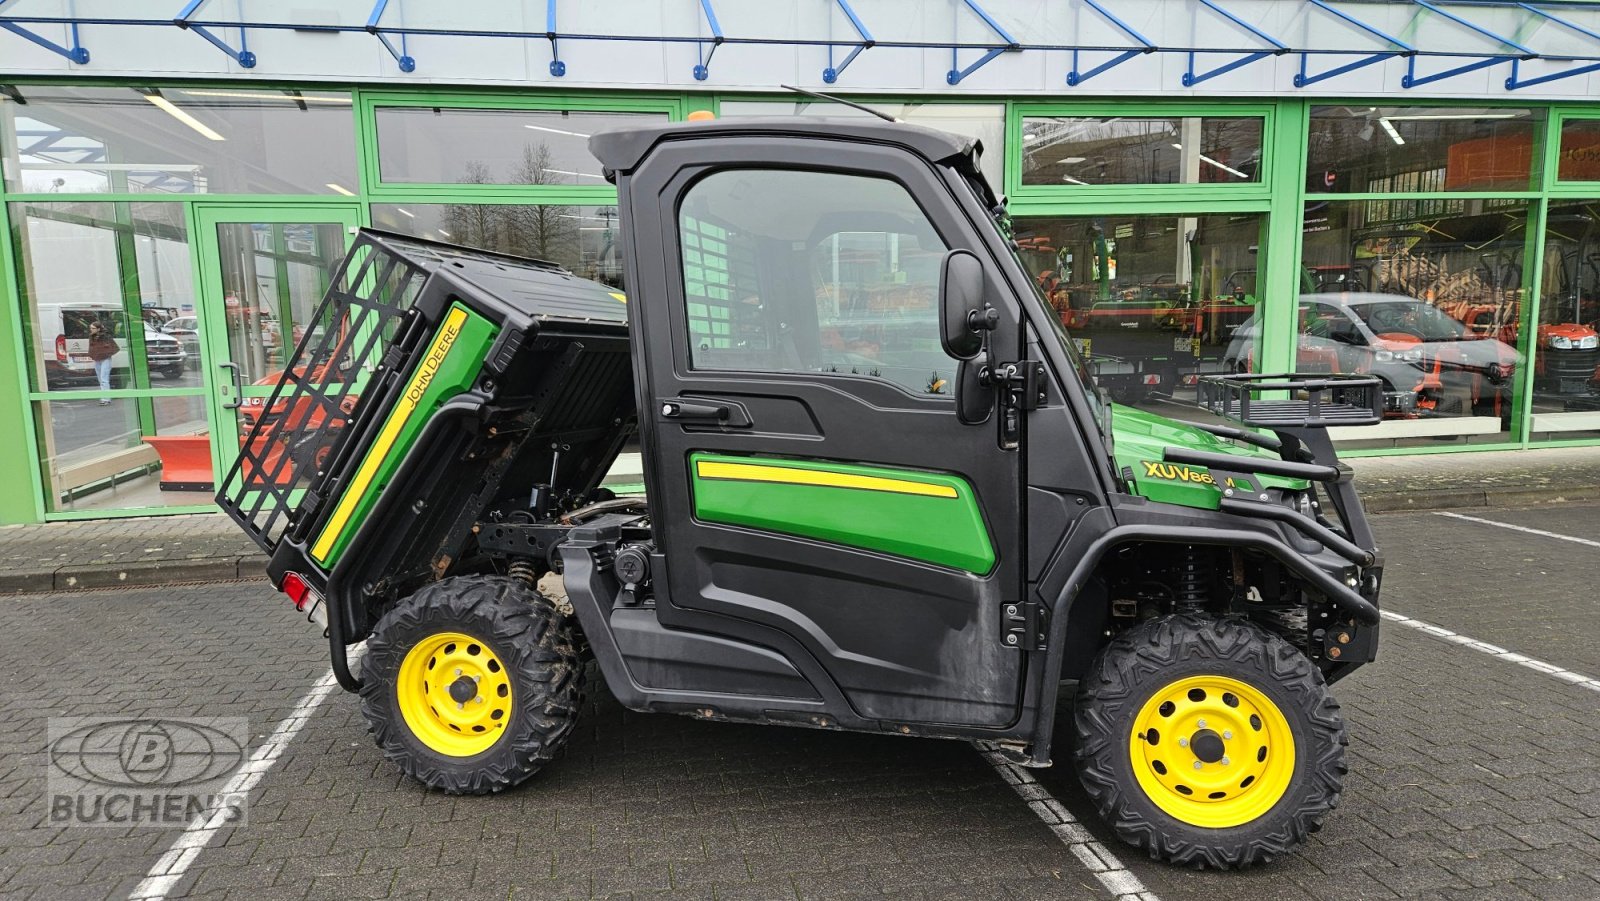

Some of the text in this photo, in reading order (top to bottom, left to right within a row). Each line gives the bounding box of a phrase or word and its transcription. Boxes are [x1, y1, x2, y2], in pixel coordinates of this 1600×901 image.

[407, 325, 458, 408] JOHN DEERE
[1142, 461, 1236, 488] XUV86M
